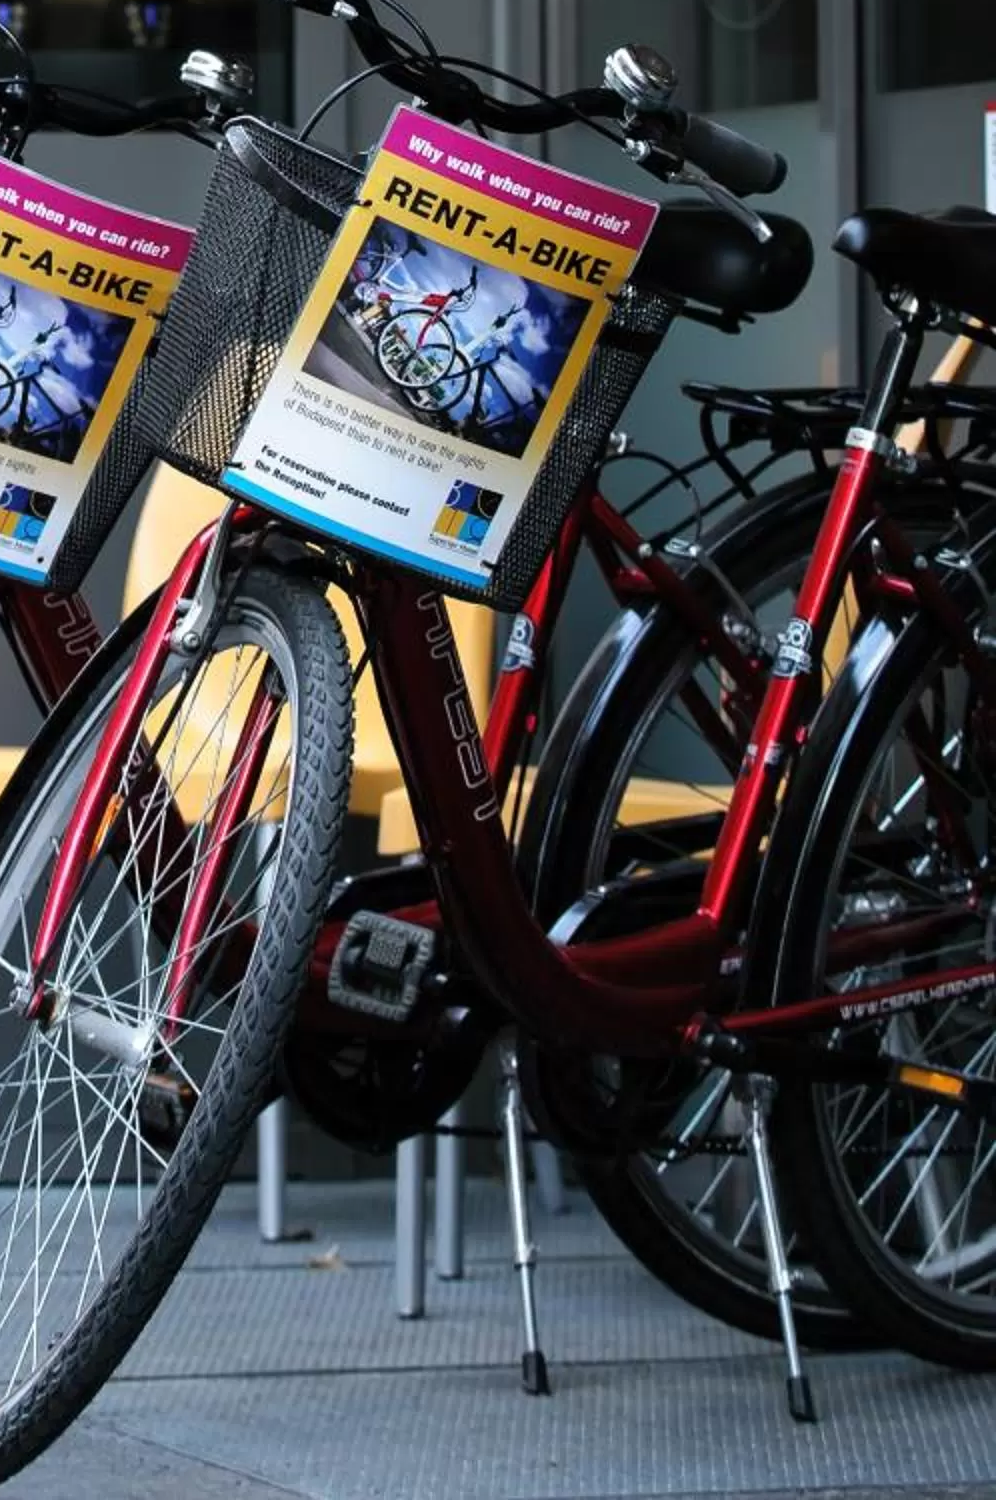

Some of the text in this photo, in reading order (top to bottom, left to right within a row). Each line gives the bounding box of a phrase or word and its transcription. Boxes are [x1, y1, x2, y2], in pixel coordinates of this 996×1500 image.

[408, 134, 632, 236] Why walk when you can ride?
[23, 199, 64, 225] when
[66, 216, 97, 238] you
[99, 229, 127, 247] can
[129, 238, 171, 259] ride?
[383, 175, 612, 287] RENT-A-BIKE
[254, 459, 326, 500] the Reception!
[261, 444, 278, 459] For
[337, 482, 372, 501] please
[372, 497, 411, 517] contact
